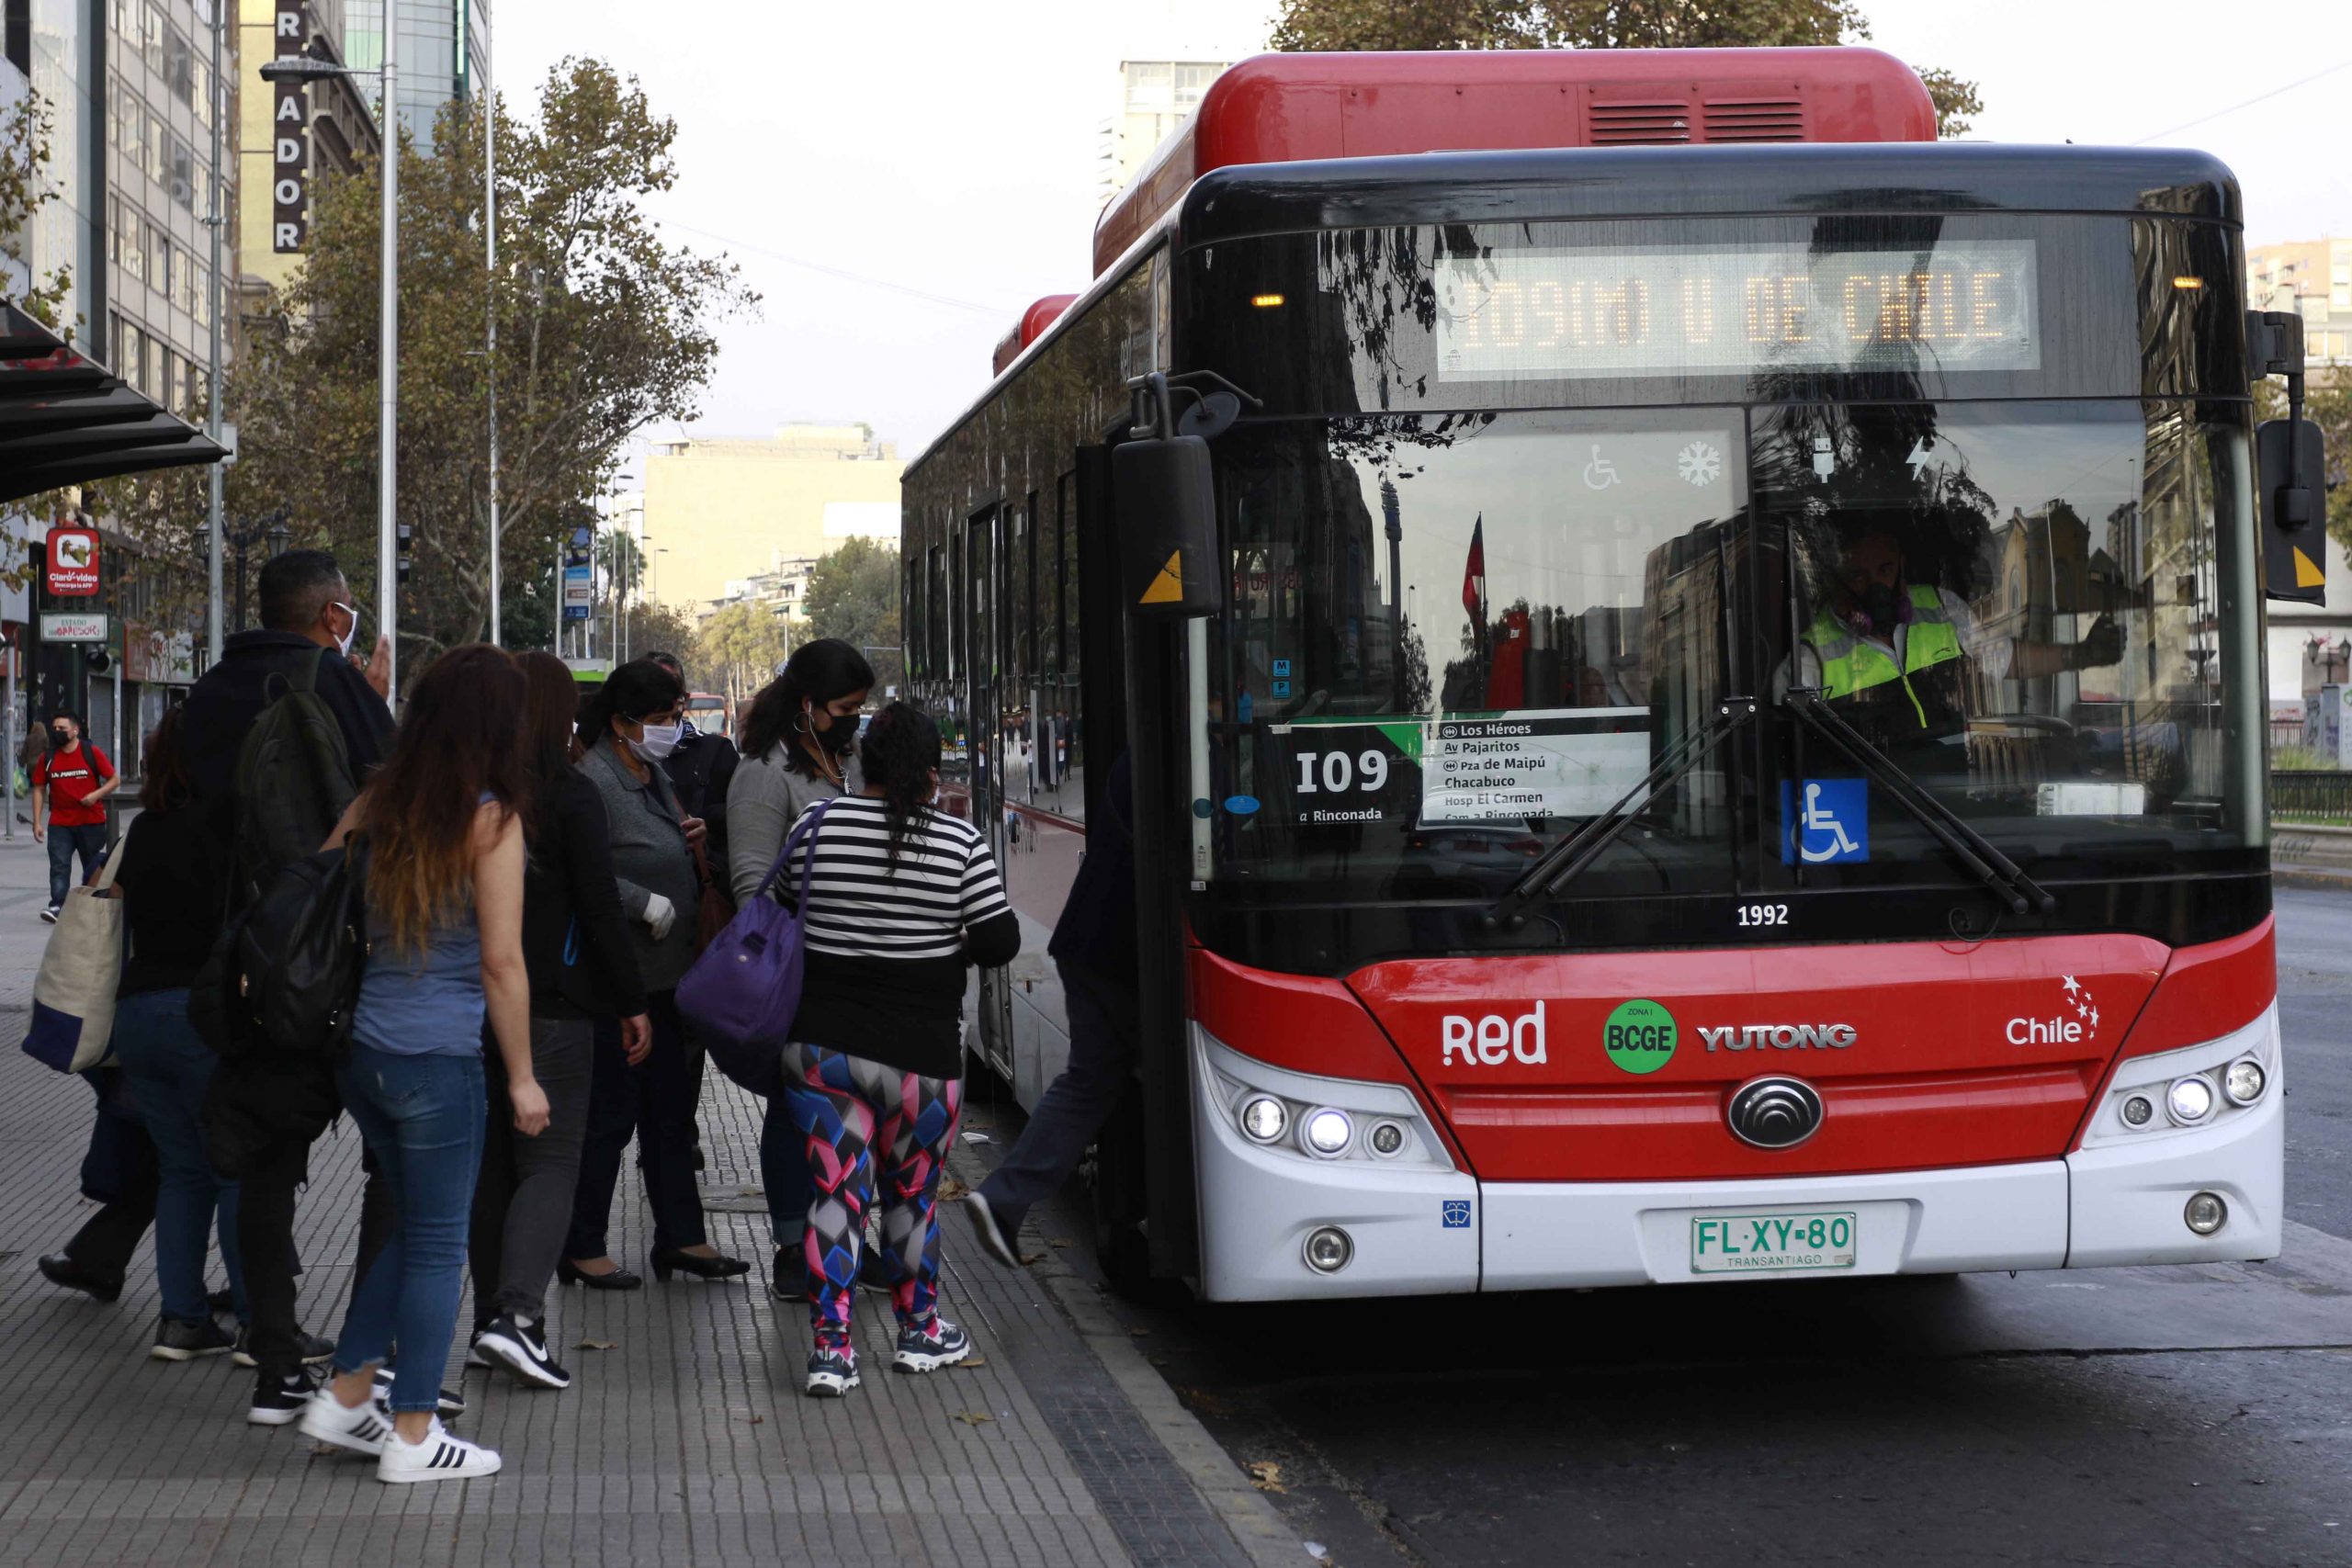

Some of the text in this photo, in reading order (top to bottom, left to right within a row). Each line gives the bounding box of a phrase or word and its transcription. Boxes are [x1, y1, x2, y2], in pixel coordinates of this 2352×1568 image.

[275, 11, 301, 248] RADOR
[1683, 277, 1713, 343] U
[1746, 276, 1812, 341] DE
[1844, 273, 2003, 338] CHILE
[1277, 660, 1286, 670] M
[1278, 682, 1285, 691] P
[1461, 723, 1532, 736] Los Héroes
[1444, 740, 1521, 755] Av Pajaritos
[1461, 756, 1545, 771] Pza de Maipú
[1296, 750, 1388, 793] I09
[1445, 775, 1516, 788] Chacabuco
[1445, 793, 1543, 807] Hosp El Carmen
[1300, 807, 1383, 822] a Rinconada
[1737, 904, 1789, 926] 1992
[1627, 1008, 1649, 1016] ZONA
[1442, 999, 1547, 1066] Red
[1697, 1023, 1857, 1052] YUTONG
[2006, 1016, 2083, 1044] Chile
[1608, 1024, 1672, 1052] BCGE
[1727, 1255, 1822, 1268] TRANSANTIAGO
